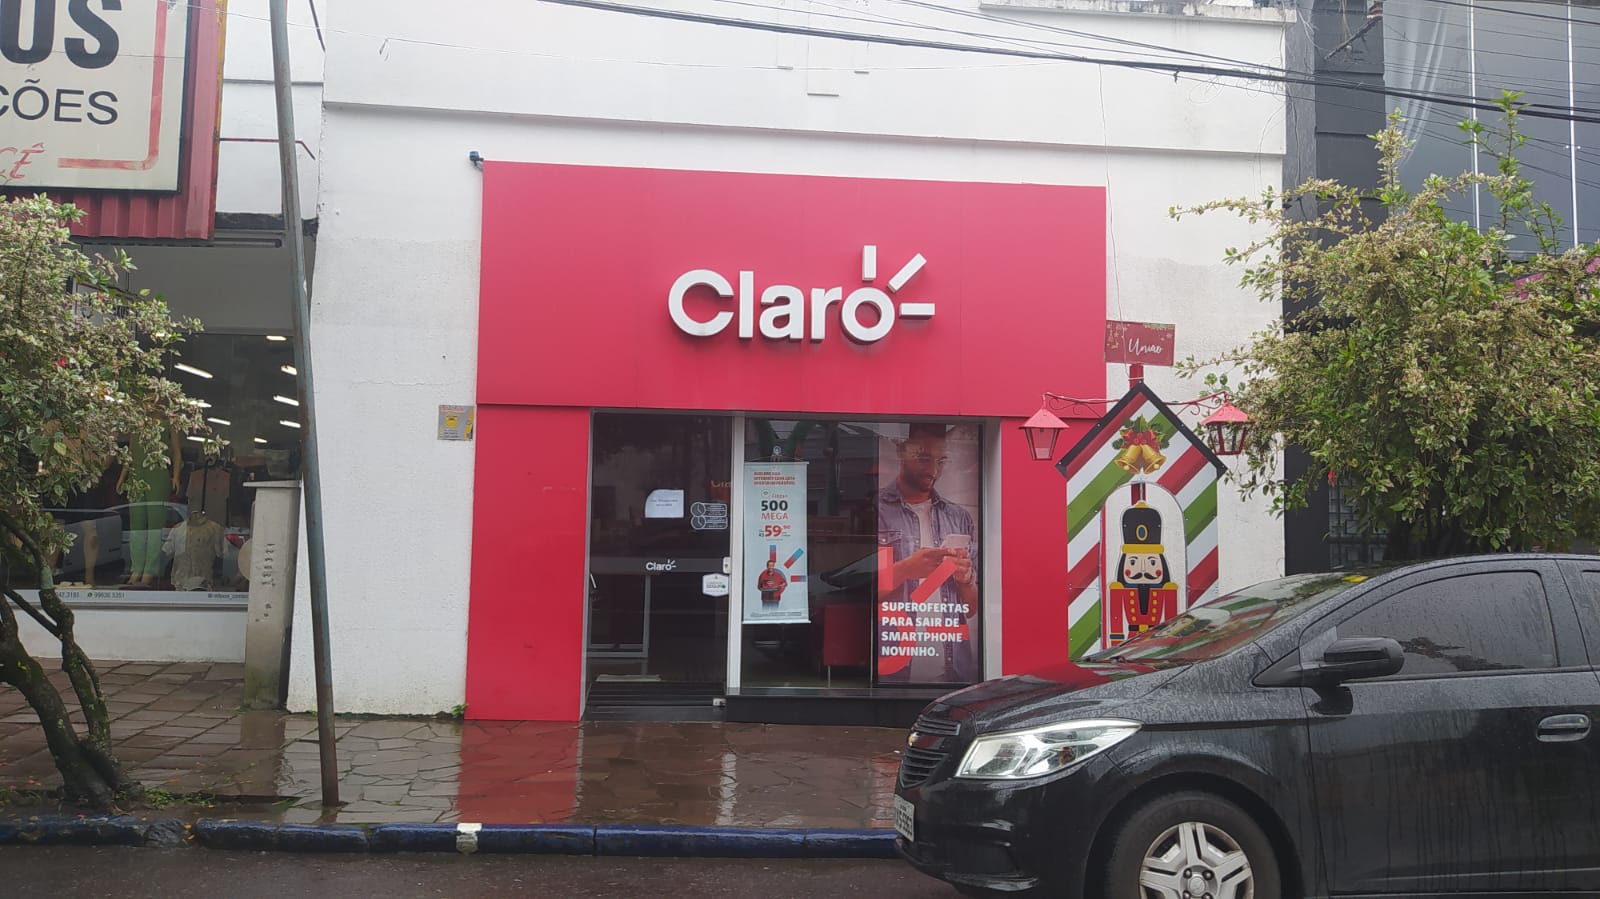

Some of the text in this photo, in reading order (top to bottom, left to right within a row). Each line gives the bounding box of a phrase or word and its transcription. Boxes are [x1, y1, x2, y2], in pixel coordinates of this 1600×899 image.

[0, 79, 118, 125] ÕES
[668, 268, 896, 342] Claro
[761, 500, 788, 511] 500
[761, 512, 788, 520] MEGA
[764, 525, 782, 537] 59
[645, 561, 673, 571] Claro
[881, 602, 970, 613] SUPEROFERTAS
[881, 617, 960, 627] PARA SAIR DE
[881, 631, 963, 642] SMARTPHONE
[881, 646, 939, 657] NOVINHO.
